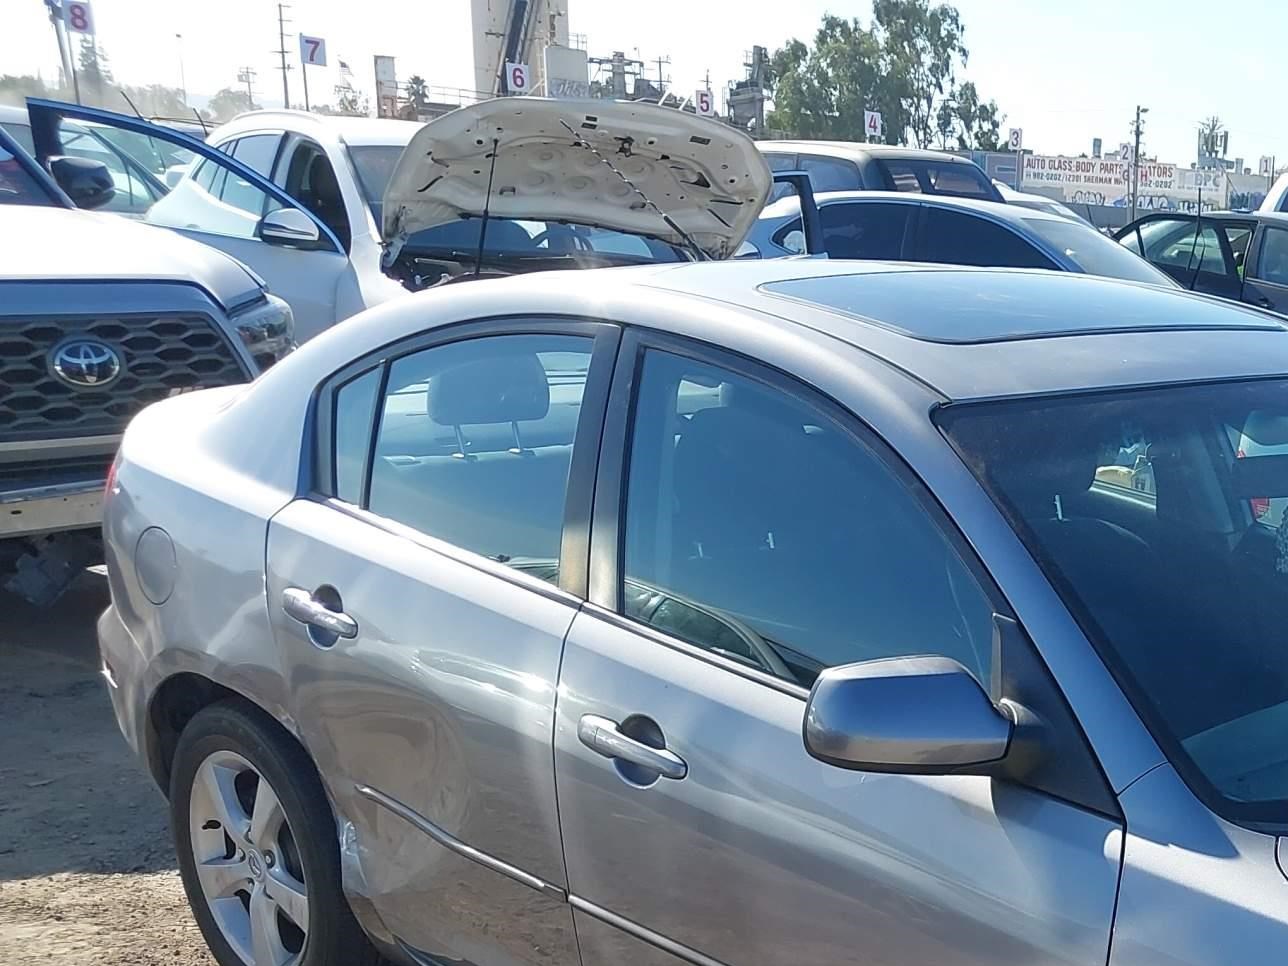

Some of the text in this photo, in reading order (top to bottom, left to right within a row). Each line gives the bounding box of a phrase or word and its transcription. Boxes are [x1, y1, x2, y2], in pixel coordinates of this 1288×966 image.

[70, 5, 88, 30] 8
[305, 40, 320, 61] 7
[512, 67, 525, 88] 6
[700, 93, 710, 112] 5
[868, 114, 878, 132] 4
[1011, 130, 1020, 147] 3
[1122, 145, 1129, 160] 2
[1026, 158, 1046, 170] AUTO
